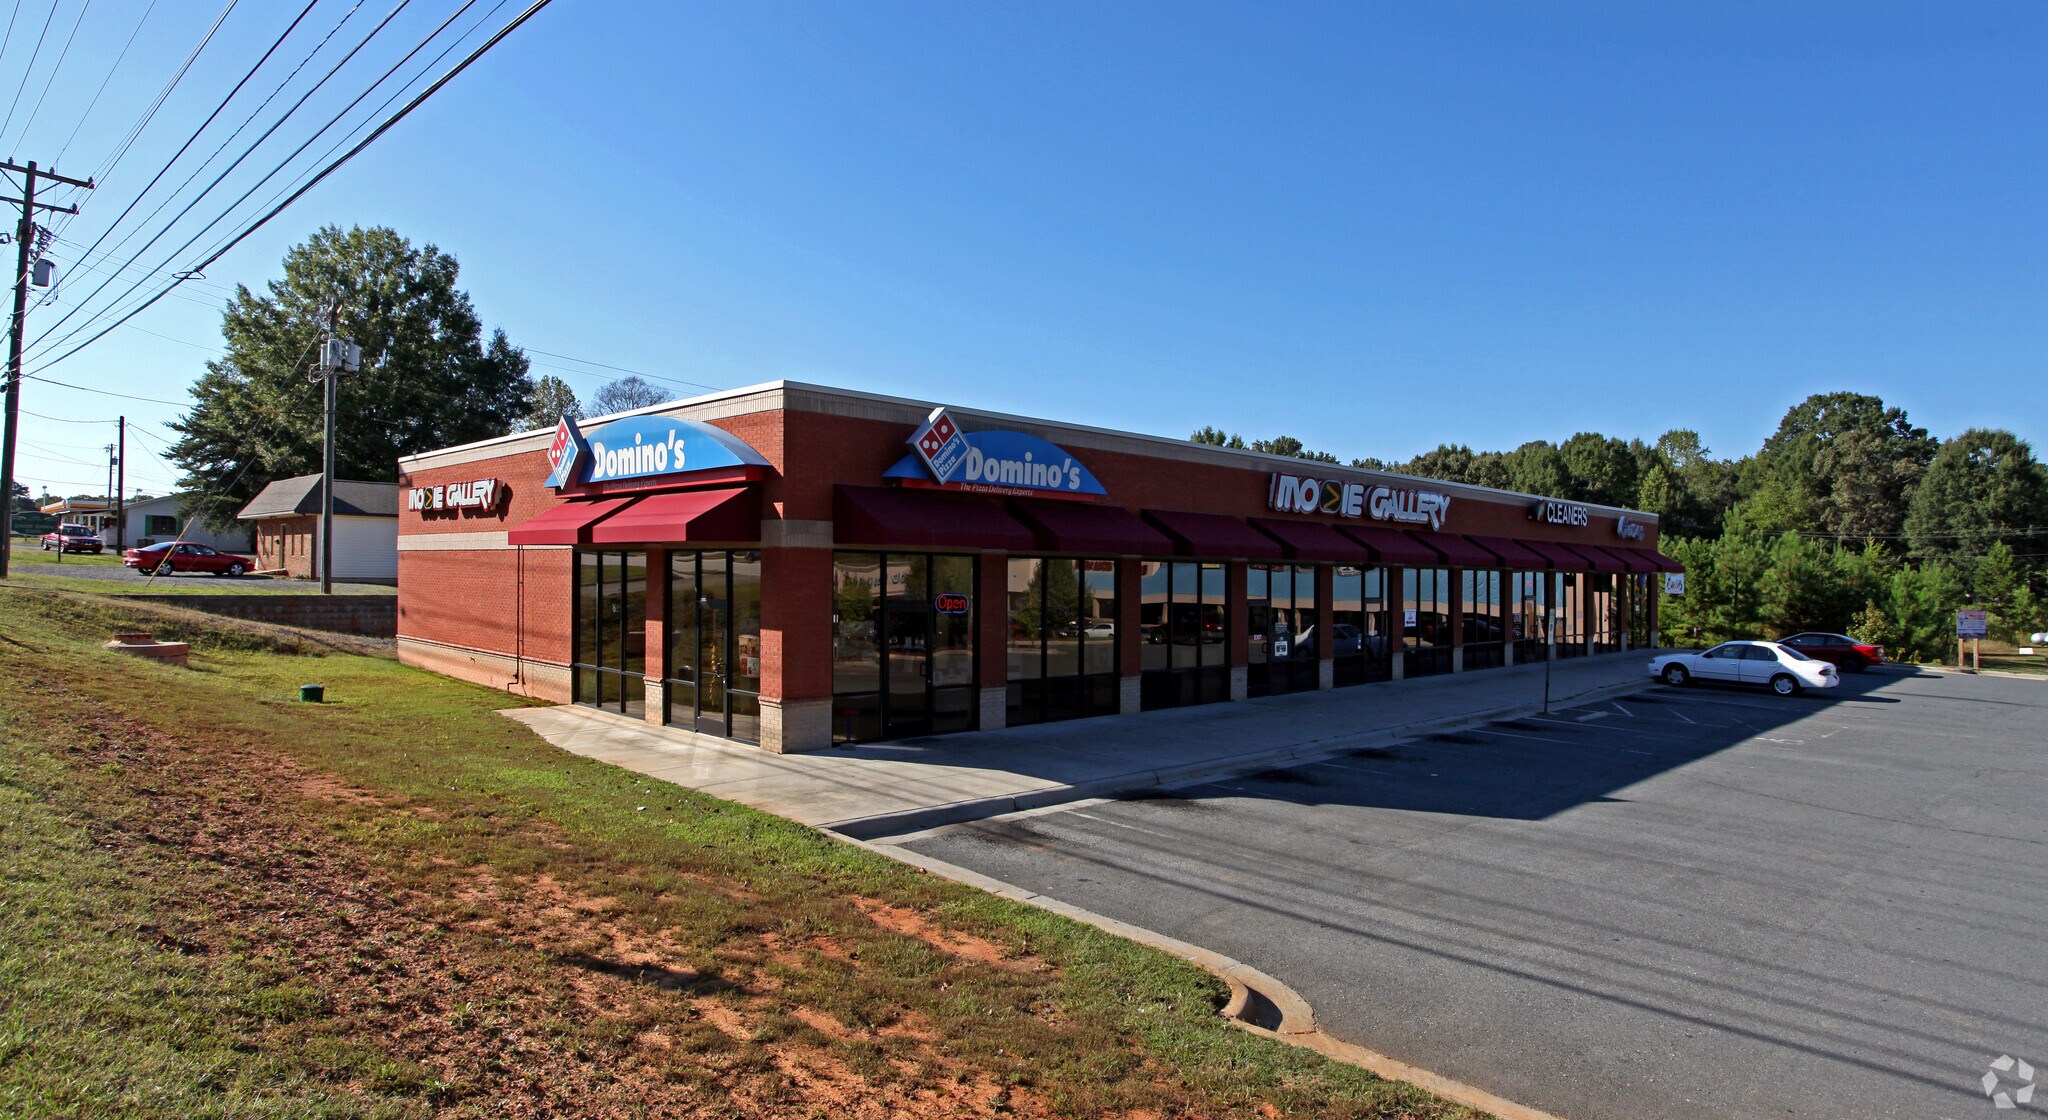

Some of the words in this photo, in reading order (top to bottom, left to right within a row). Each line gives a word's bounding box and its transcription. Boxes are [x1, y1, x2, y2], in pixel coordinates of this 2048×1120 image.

[594, 429, 686, 479] Domino's
[933, 437, 960, 469] Domino's
[938, 455, 957, 477] Pizza
[965, 447, 1081, 490] Domino's
[408, 486, 445, 511] MOVIE
[446, 479, 496, 511] GALLERY
[960, 482, 971, 491] The
[972, 483, 988, 492] Pizza
[989, 485, 1012, 495] Delivery
[1012, 487, 1033, 497] Experts
[1274, 474, 1364, 518] MOVIE
[1368, 485, 1451, 531] GALLERY
[1547, 502, 1588, 527] CLEANERS
[937, 595, 966, 612] Open
